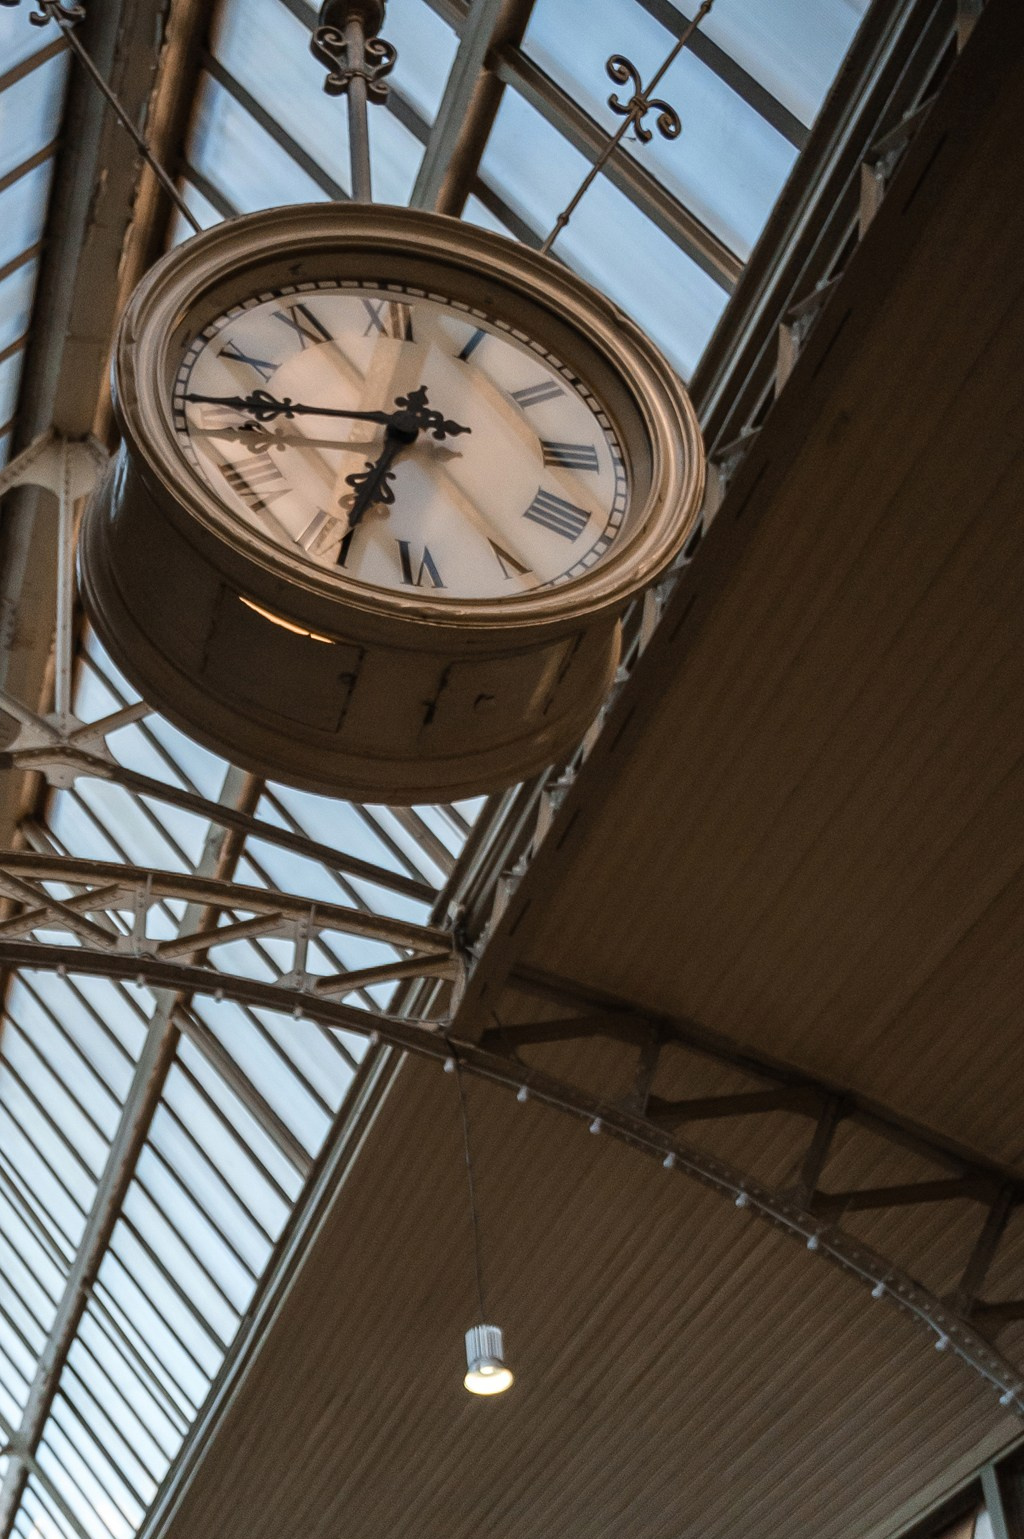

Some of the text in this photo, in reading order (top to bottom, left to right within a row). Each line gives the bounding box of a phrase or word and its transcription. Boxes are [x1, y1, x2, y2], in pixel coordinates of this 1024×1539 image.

[270, 303, 334, 350] XI
[360, 299, 417, 343] XII
[217, 338, 282, 382] X
[455, 328, 487, 364] I
[505, 380, 567, 410] II
[538, 437, 599, 475] III
[217, 452, 293, 512] VIII
[522, 486, 592, 544] IIII
[395, 539, 448, 588] VI
[487, 537, 533, 580] V
